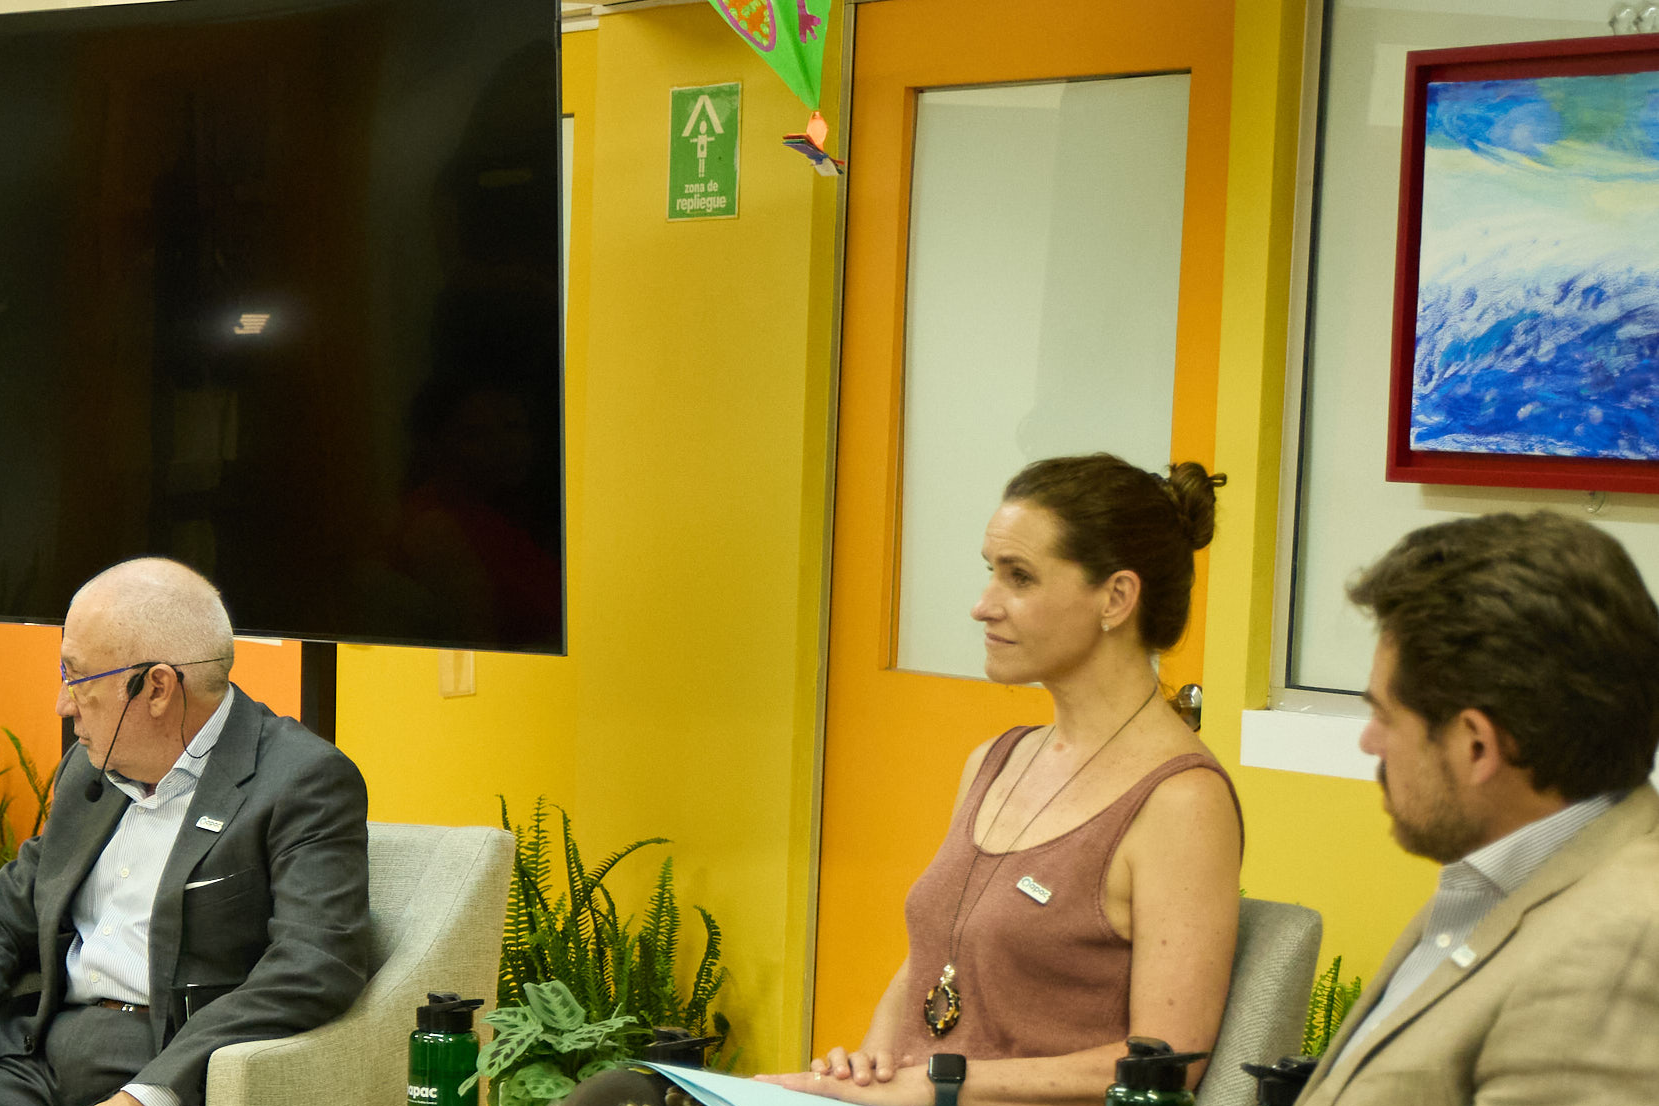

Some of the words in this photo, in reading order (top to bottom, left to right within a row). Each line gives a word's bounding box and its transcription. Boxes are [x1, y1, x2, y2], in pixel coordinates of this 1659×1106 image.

[684, 183, 705, 194] zona
[707, 180, 719, 192] de
[676, 194, 727, 213] repliegue
